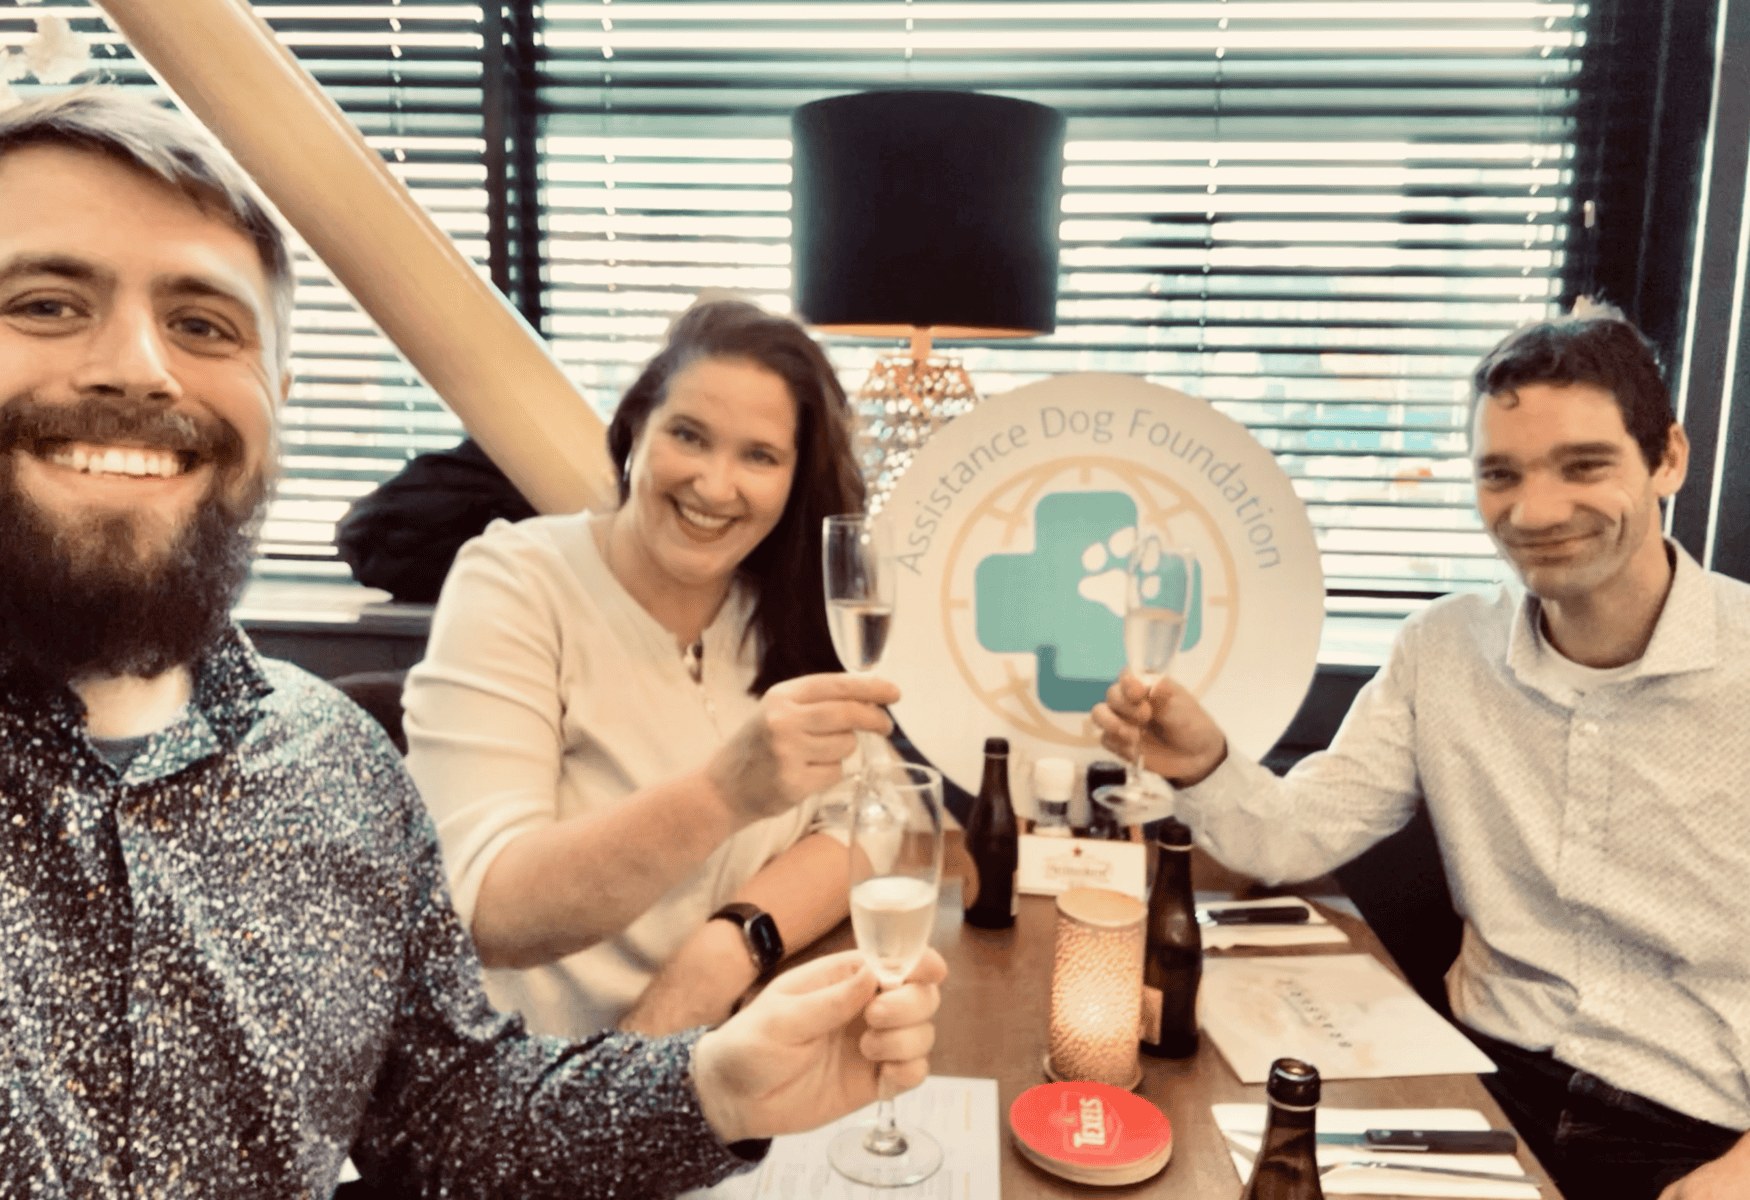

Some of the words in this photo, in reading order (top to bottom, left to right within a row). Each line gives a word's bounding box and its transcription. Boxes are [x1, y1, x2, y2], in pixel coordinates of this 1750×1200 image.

[897, 425, 1029, 576] Assistance
[1041, 406, 1114, 443] Dog
[1128, 408, 1281, 569] Foundation
